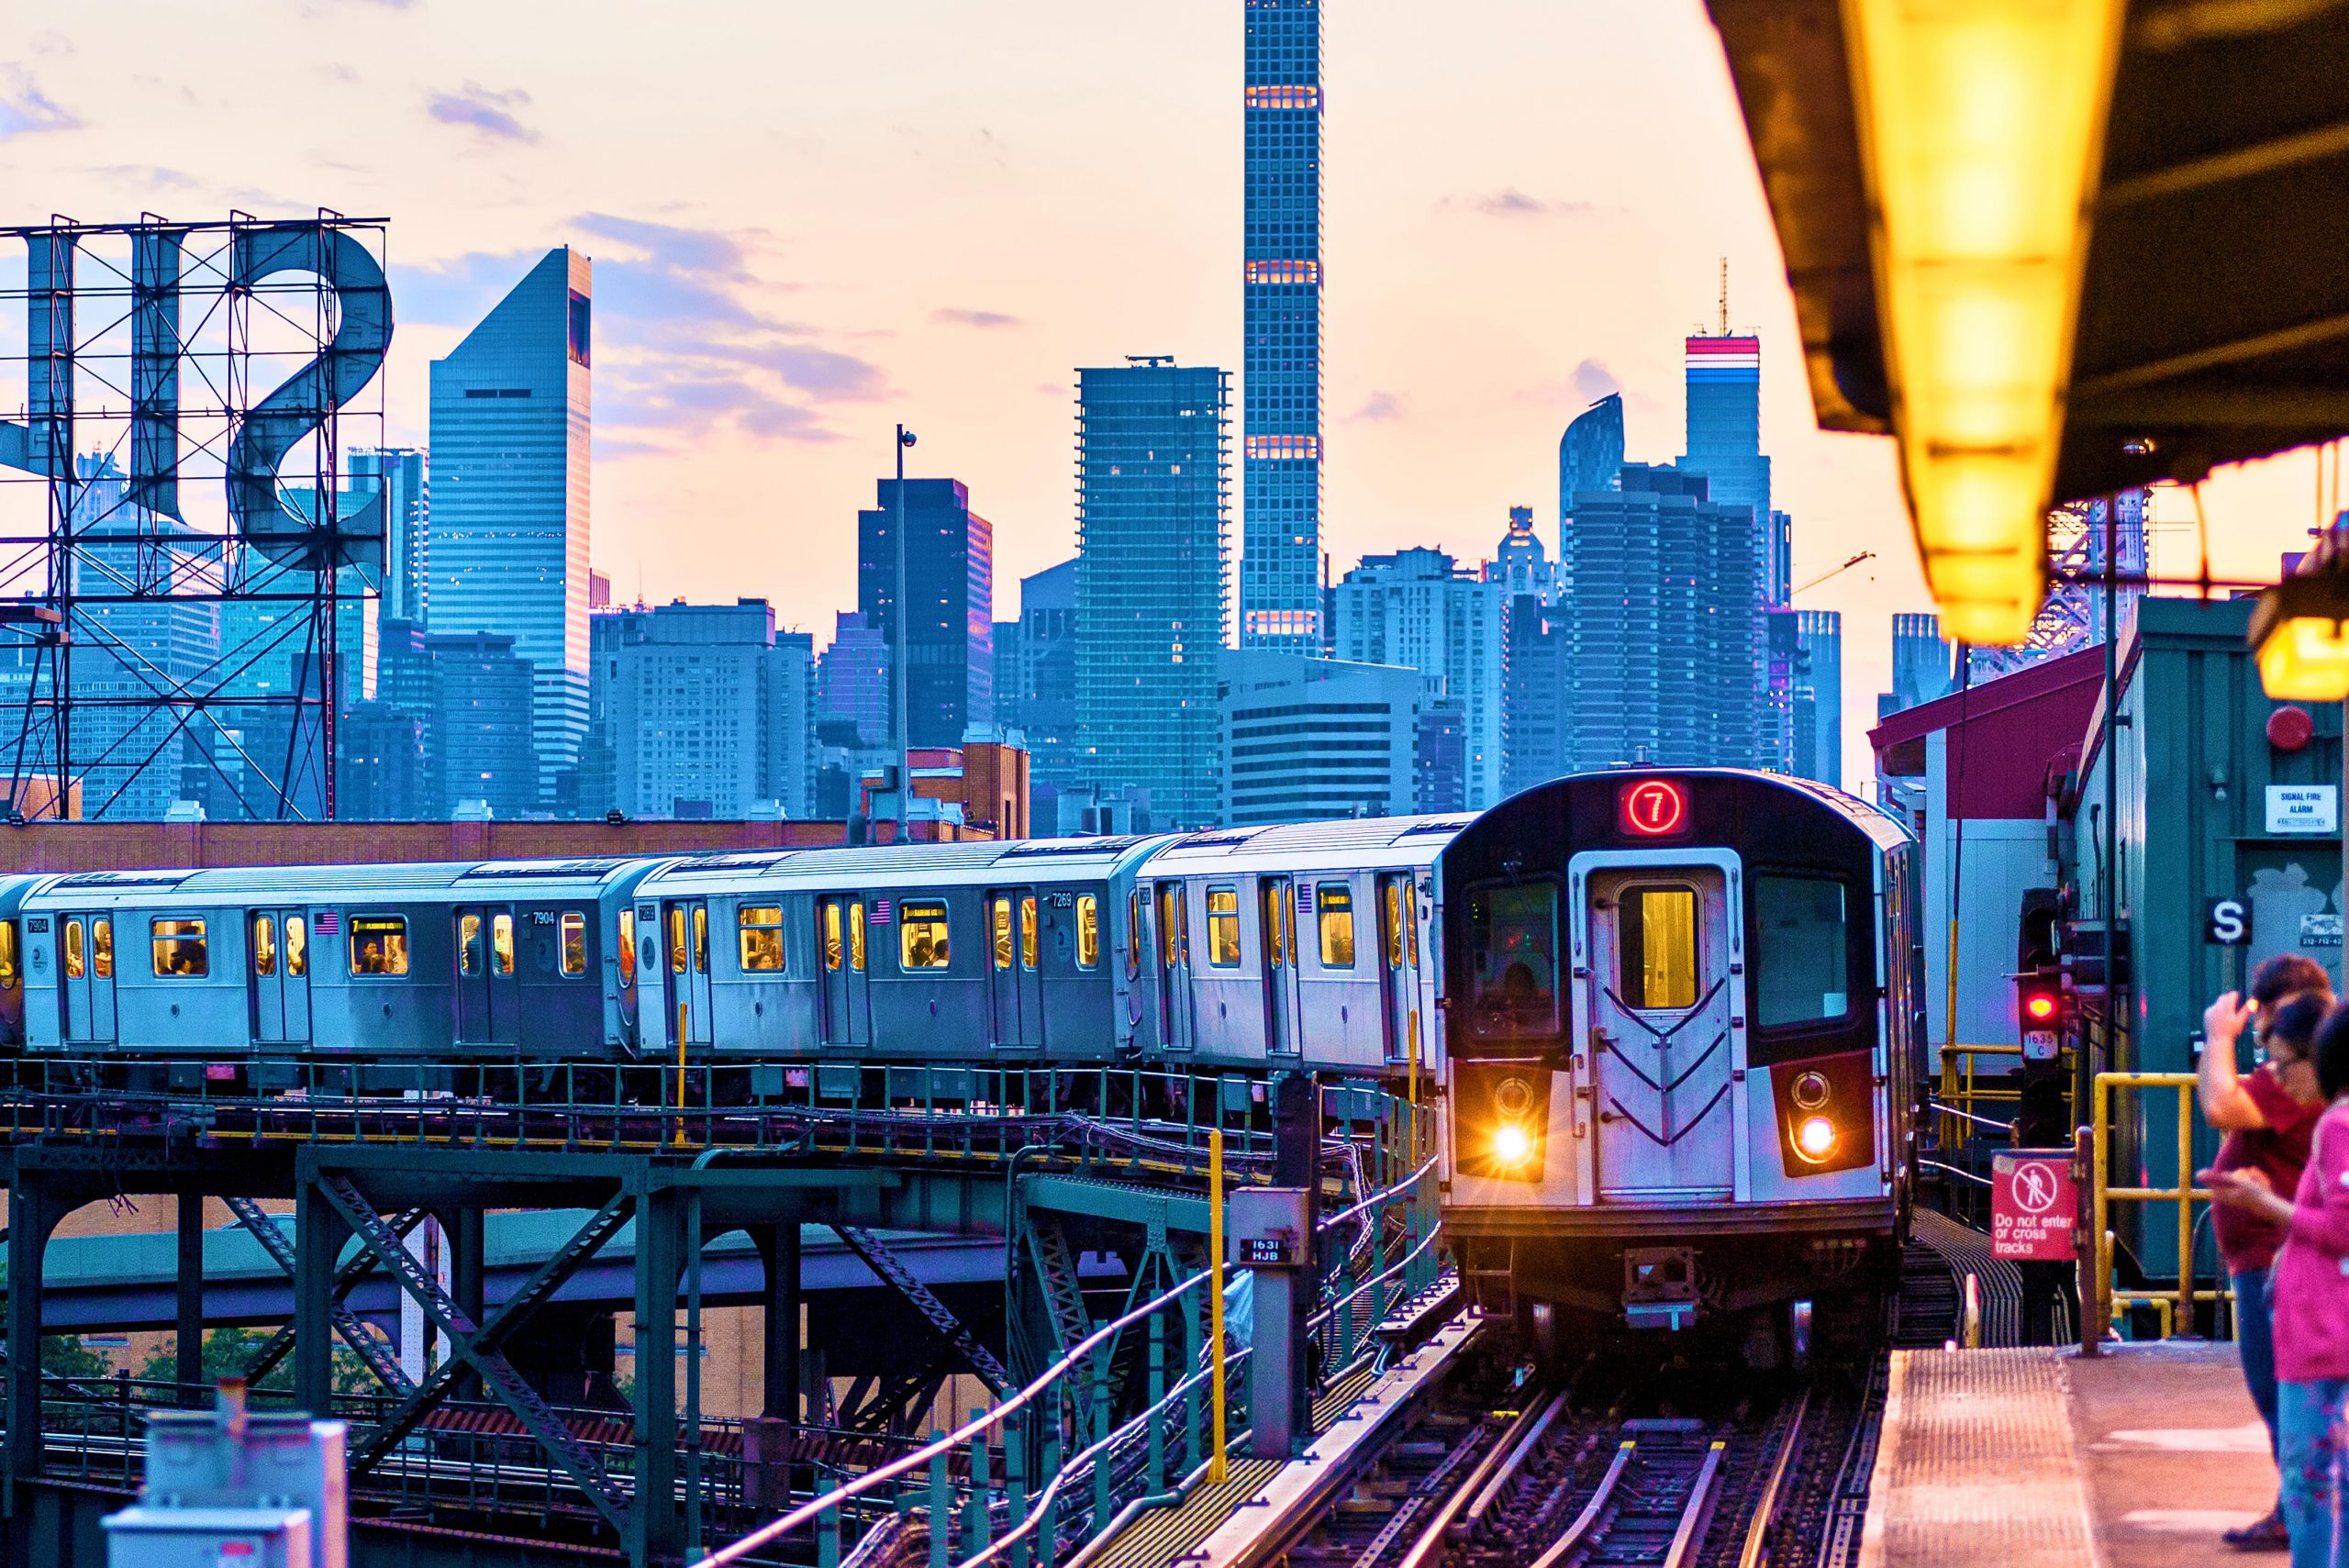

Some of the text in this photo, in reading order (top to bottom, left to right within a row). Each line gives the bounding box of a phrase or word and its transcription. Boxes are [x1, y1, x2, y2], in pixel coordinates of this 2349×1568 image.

[2281, 793, 2321, 801] SIGNAL FIRE
[1644, 793, 1663, 821] 7
[2289, 805, 2313, 814] ALARM
[1052, 893, 1072, 907] 7269
[533, 911, 554, 925] 7904
[639, 906, 654, 919] 7269
[28, 919, 47, 931] 7904
[352, 919, 359, 933] 7
[2213, 901, 2243, 940] S
[2028, 1034, 2053, 1044] 1635
[2037, 1045, 2044, 1056] C
[1995, 1213, 2073, 1228] Do not enter
[1995, 1228, 2047, 1240] or cross
[1252, 1240, 1279, 1250] 1631
[1995, 1240, 2034, 1254] tracks
[1252, 1251, 1278, 1261] HJB
